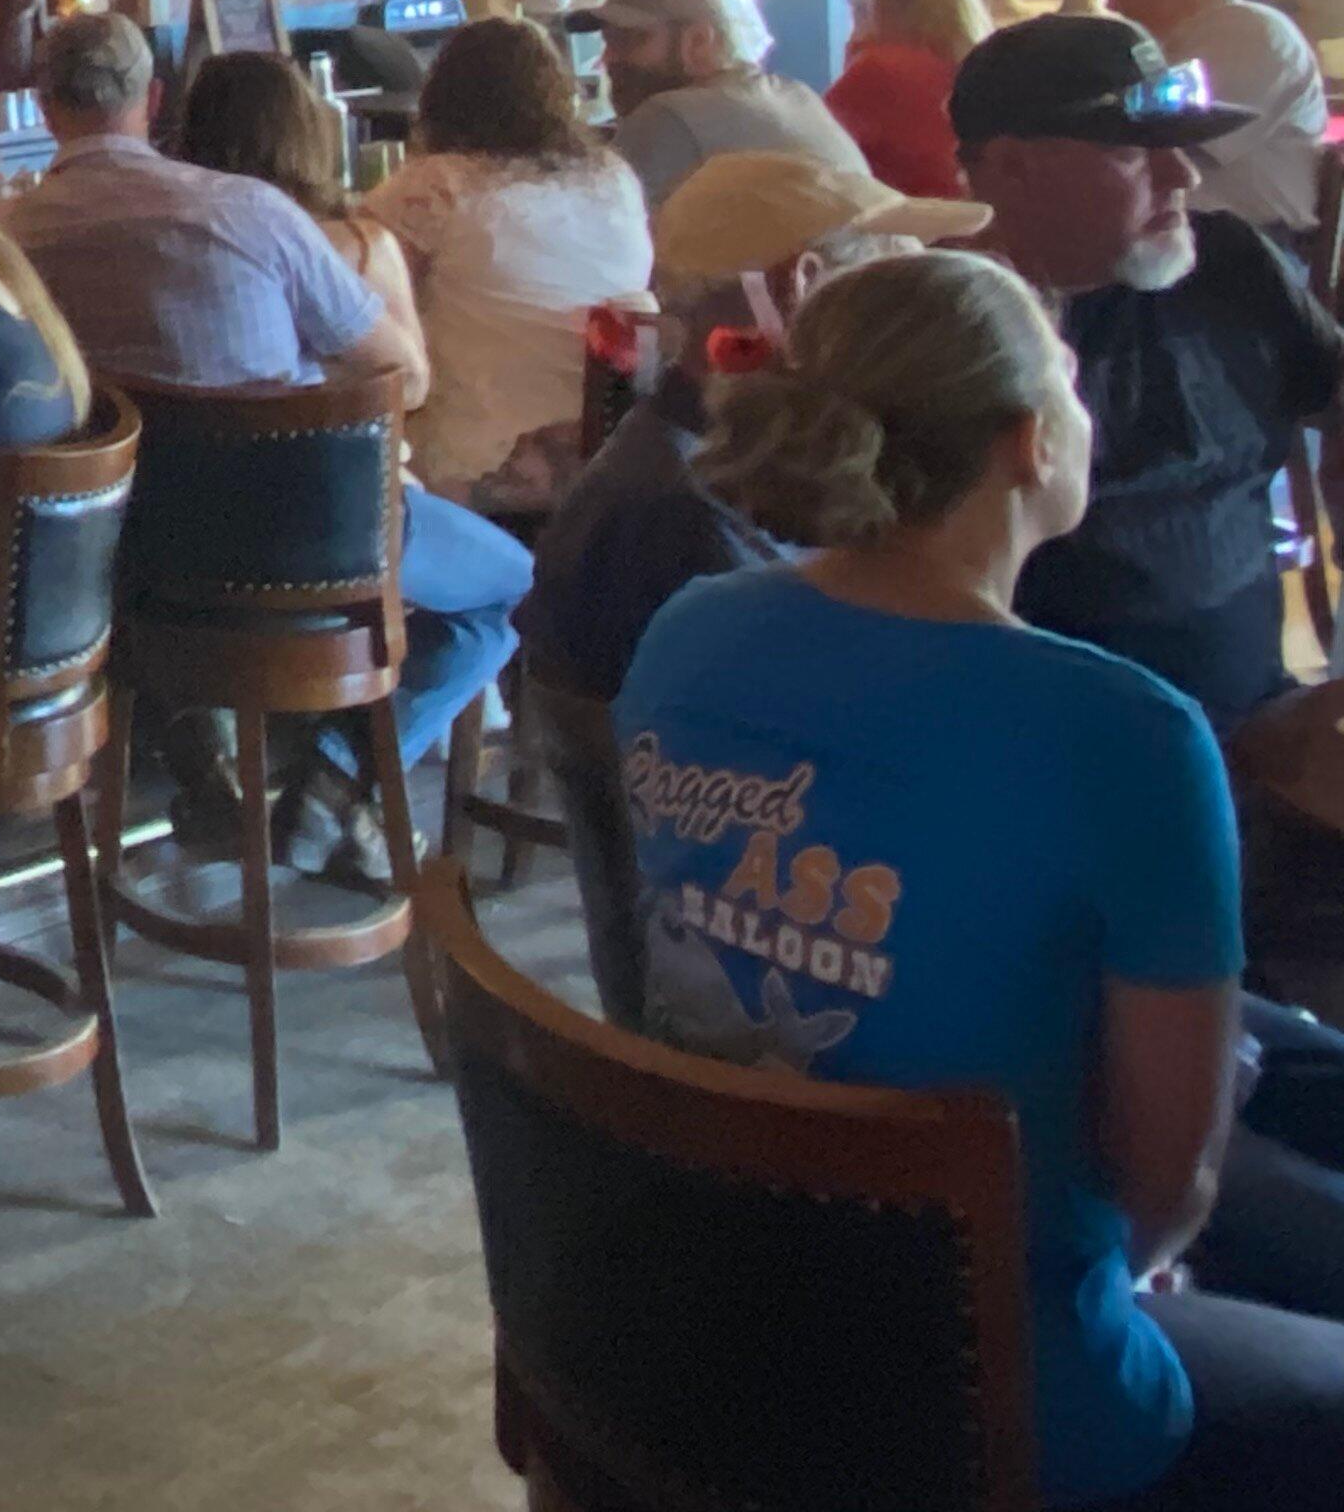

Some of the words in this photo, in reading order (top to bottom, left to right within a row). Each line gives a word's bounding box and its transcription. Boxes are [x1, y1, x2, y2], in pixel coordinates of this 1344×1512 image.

[623, 730, 817, 843] Ragged
[680, 881, 894, 999] SALOON
[720, 830, 902, 945] ASS
